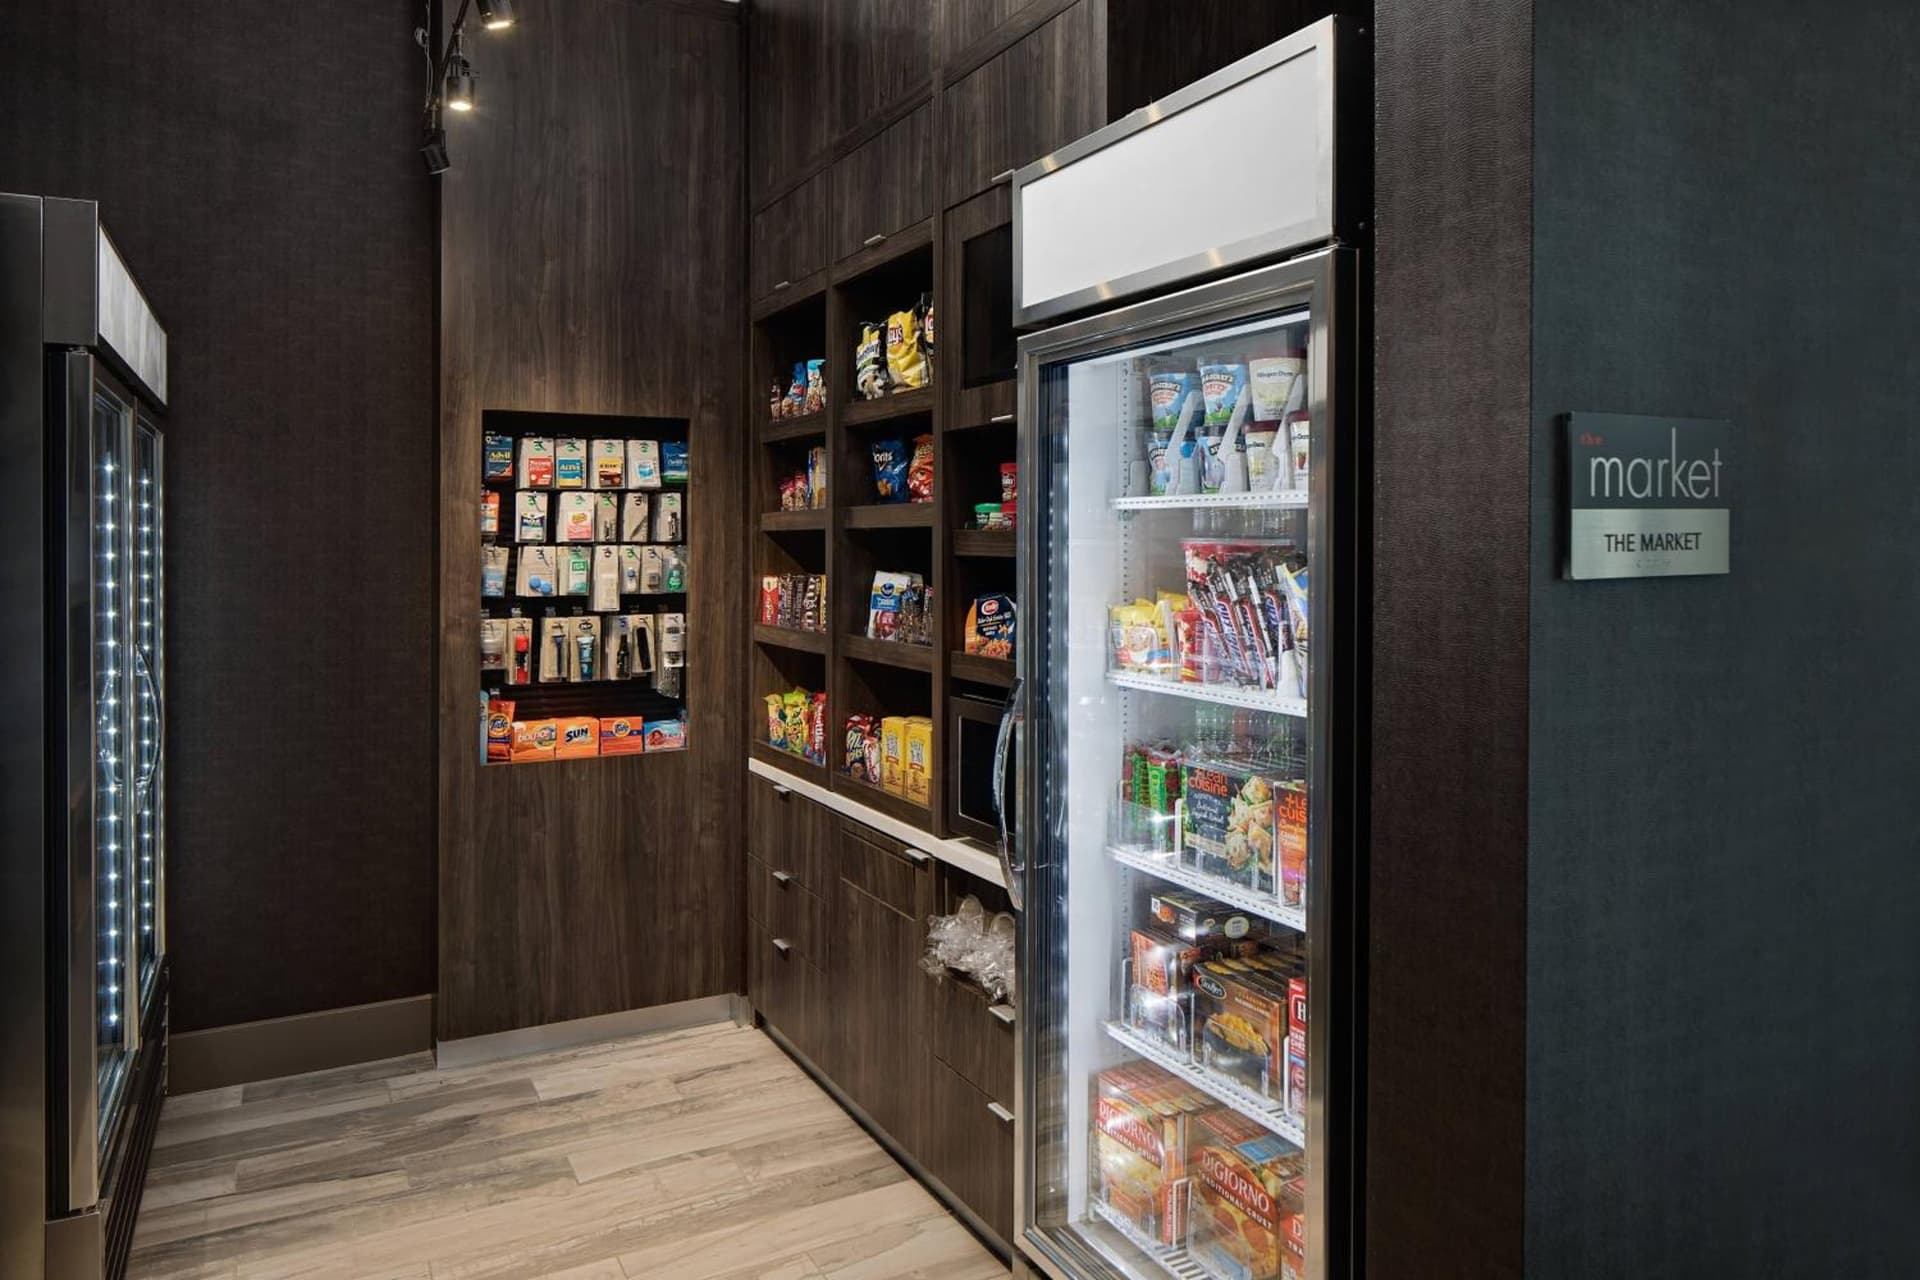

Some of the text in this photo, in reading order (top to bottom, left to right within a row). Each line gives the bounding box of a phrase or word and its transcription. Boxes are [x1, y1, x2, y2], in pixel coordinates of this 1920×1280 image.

[1580, 433, 1604, 446] the
[1591, 427, 1723, 499] market
[1604, 532, 1702, 552] THE MARKET
[566, 727, 588, 743] SUN
[1203, 1150, 1270, 1213] DIGIORNO
